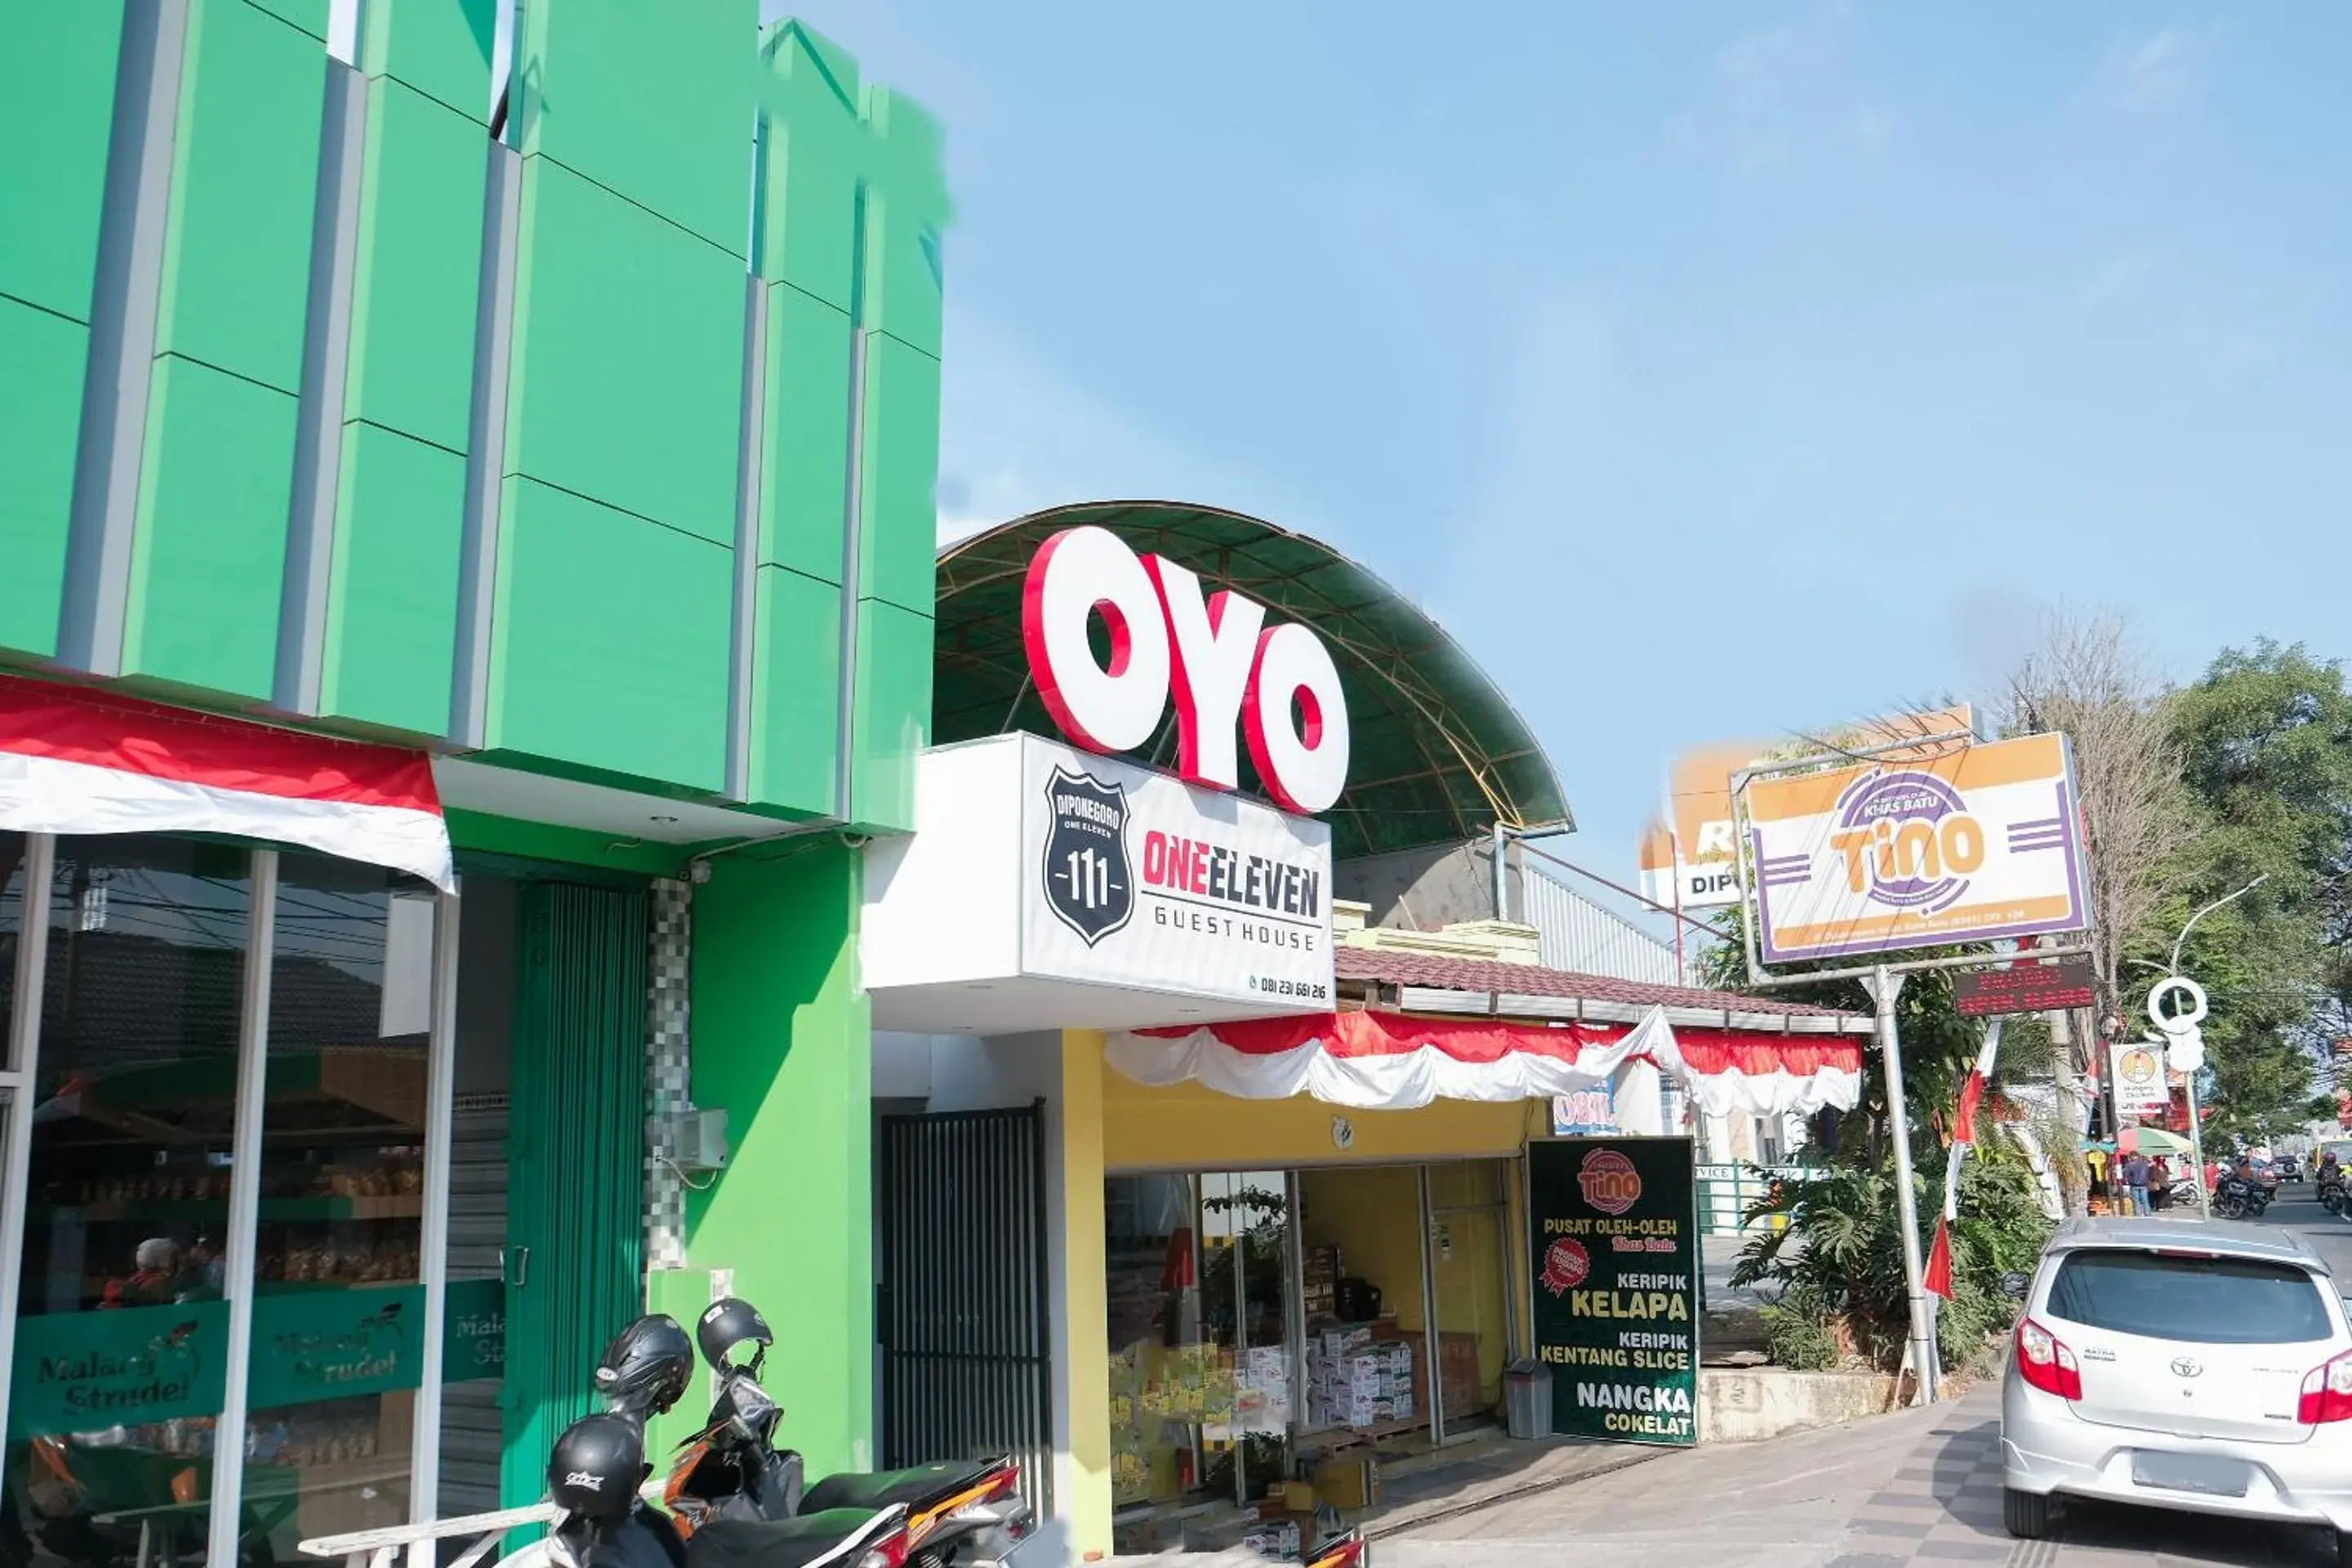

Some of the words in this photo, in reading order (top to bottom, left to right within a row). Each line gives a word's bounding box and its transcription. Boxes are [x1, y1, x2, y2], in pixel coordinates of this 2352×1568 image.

[1022, 525, 1350, 814] OYO
[1056, 794, 1120, 830] DIPONEGORO
[1864, 800, 1900, 817] KHAS
[1904, 795, 1939, 813] BATU
[1064, 820, 1080, 831] ONE
[1081, 822, 1111, 839] ELEVEN
[1155, 906, 1233, 938] GUEST
[1242, 925, 1315, 951] HOUSE
[1262, 978, 1277, 993] 081
[1544, 1218, 1592, 1235] PUSAT
[1596, 1218, 1677, 1236] OLEH-OLEH
[1618, 1272, 1687, 1290] KERIPIK
[1571, 1290, 1688, 1321] KELAPA
[454, 1311, 506, 1339] Mala
[1619, 1331, 1688, 1350] KERIPIK
[1540, 1345, 1628, 1366] KENTANG
[1633, 1350, 1690, 1370] SLICE
[64, 1372, 189, 1417] Strudel
[1577, 1382, 1691, 1414] NANGKA
[1605, 1412, 1691, 1436] COKELAT
